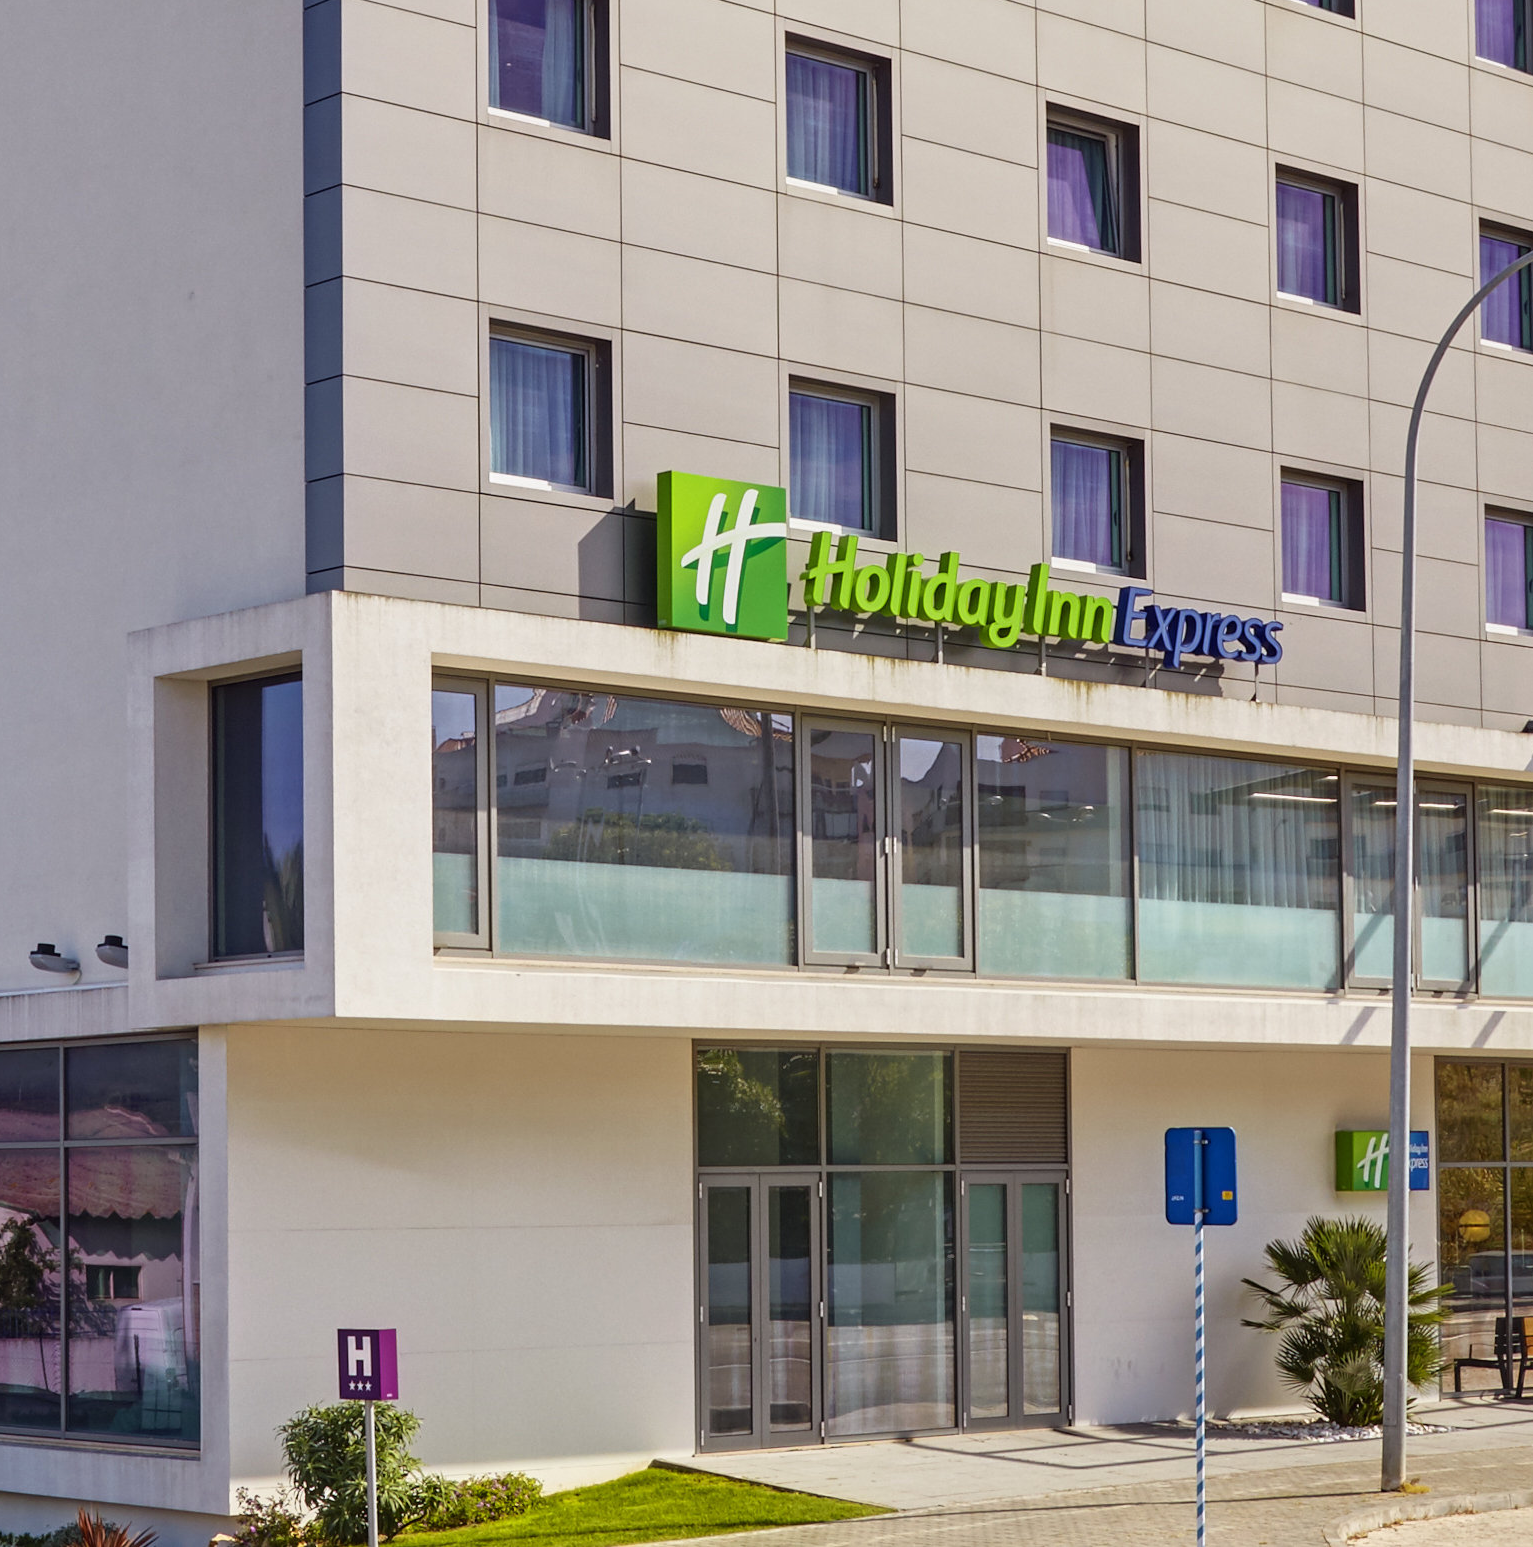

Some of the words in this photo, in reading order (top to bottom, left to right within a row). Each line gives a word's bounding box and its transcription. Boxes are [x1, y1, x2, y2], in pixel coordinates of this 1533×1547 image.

[799, 531, 1026, 648] Holiday
[1026, 563, 1113, 644] Inn
[1114, 585, 1284, 669] Express
[347, 1335, 372, 1377] H
